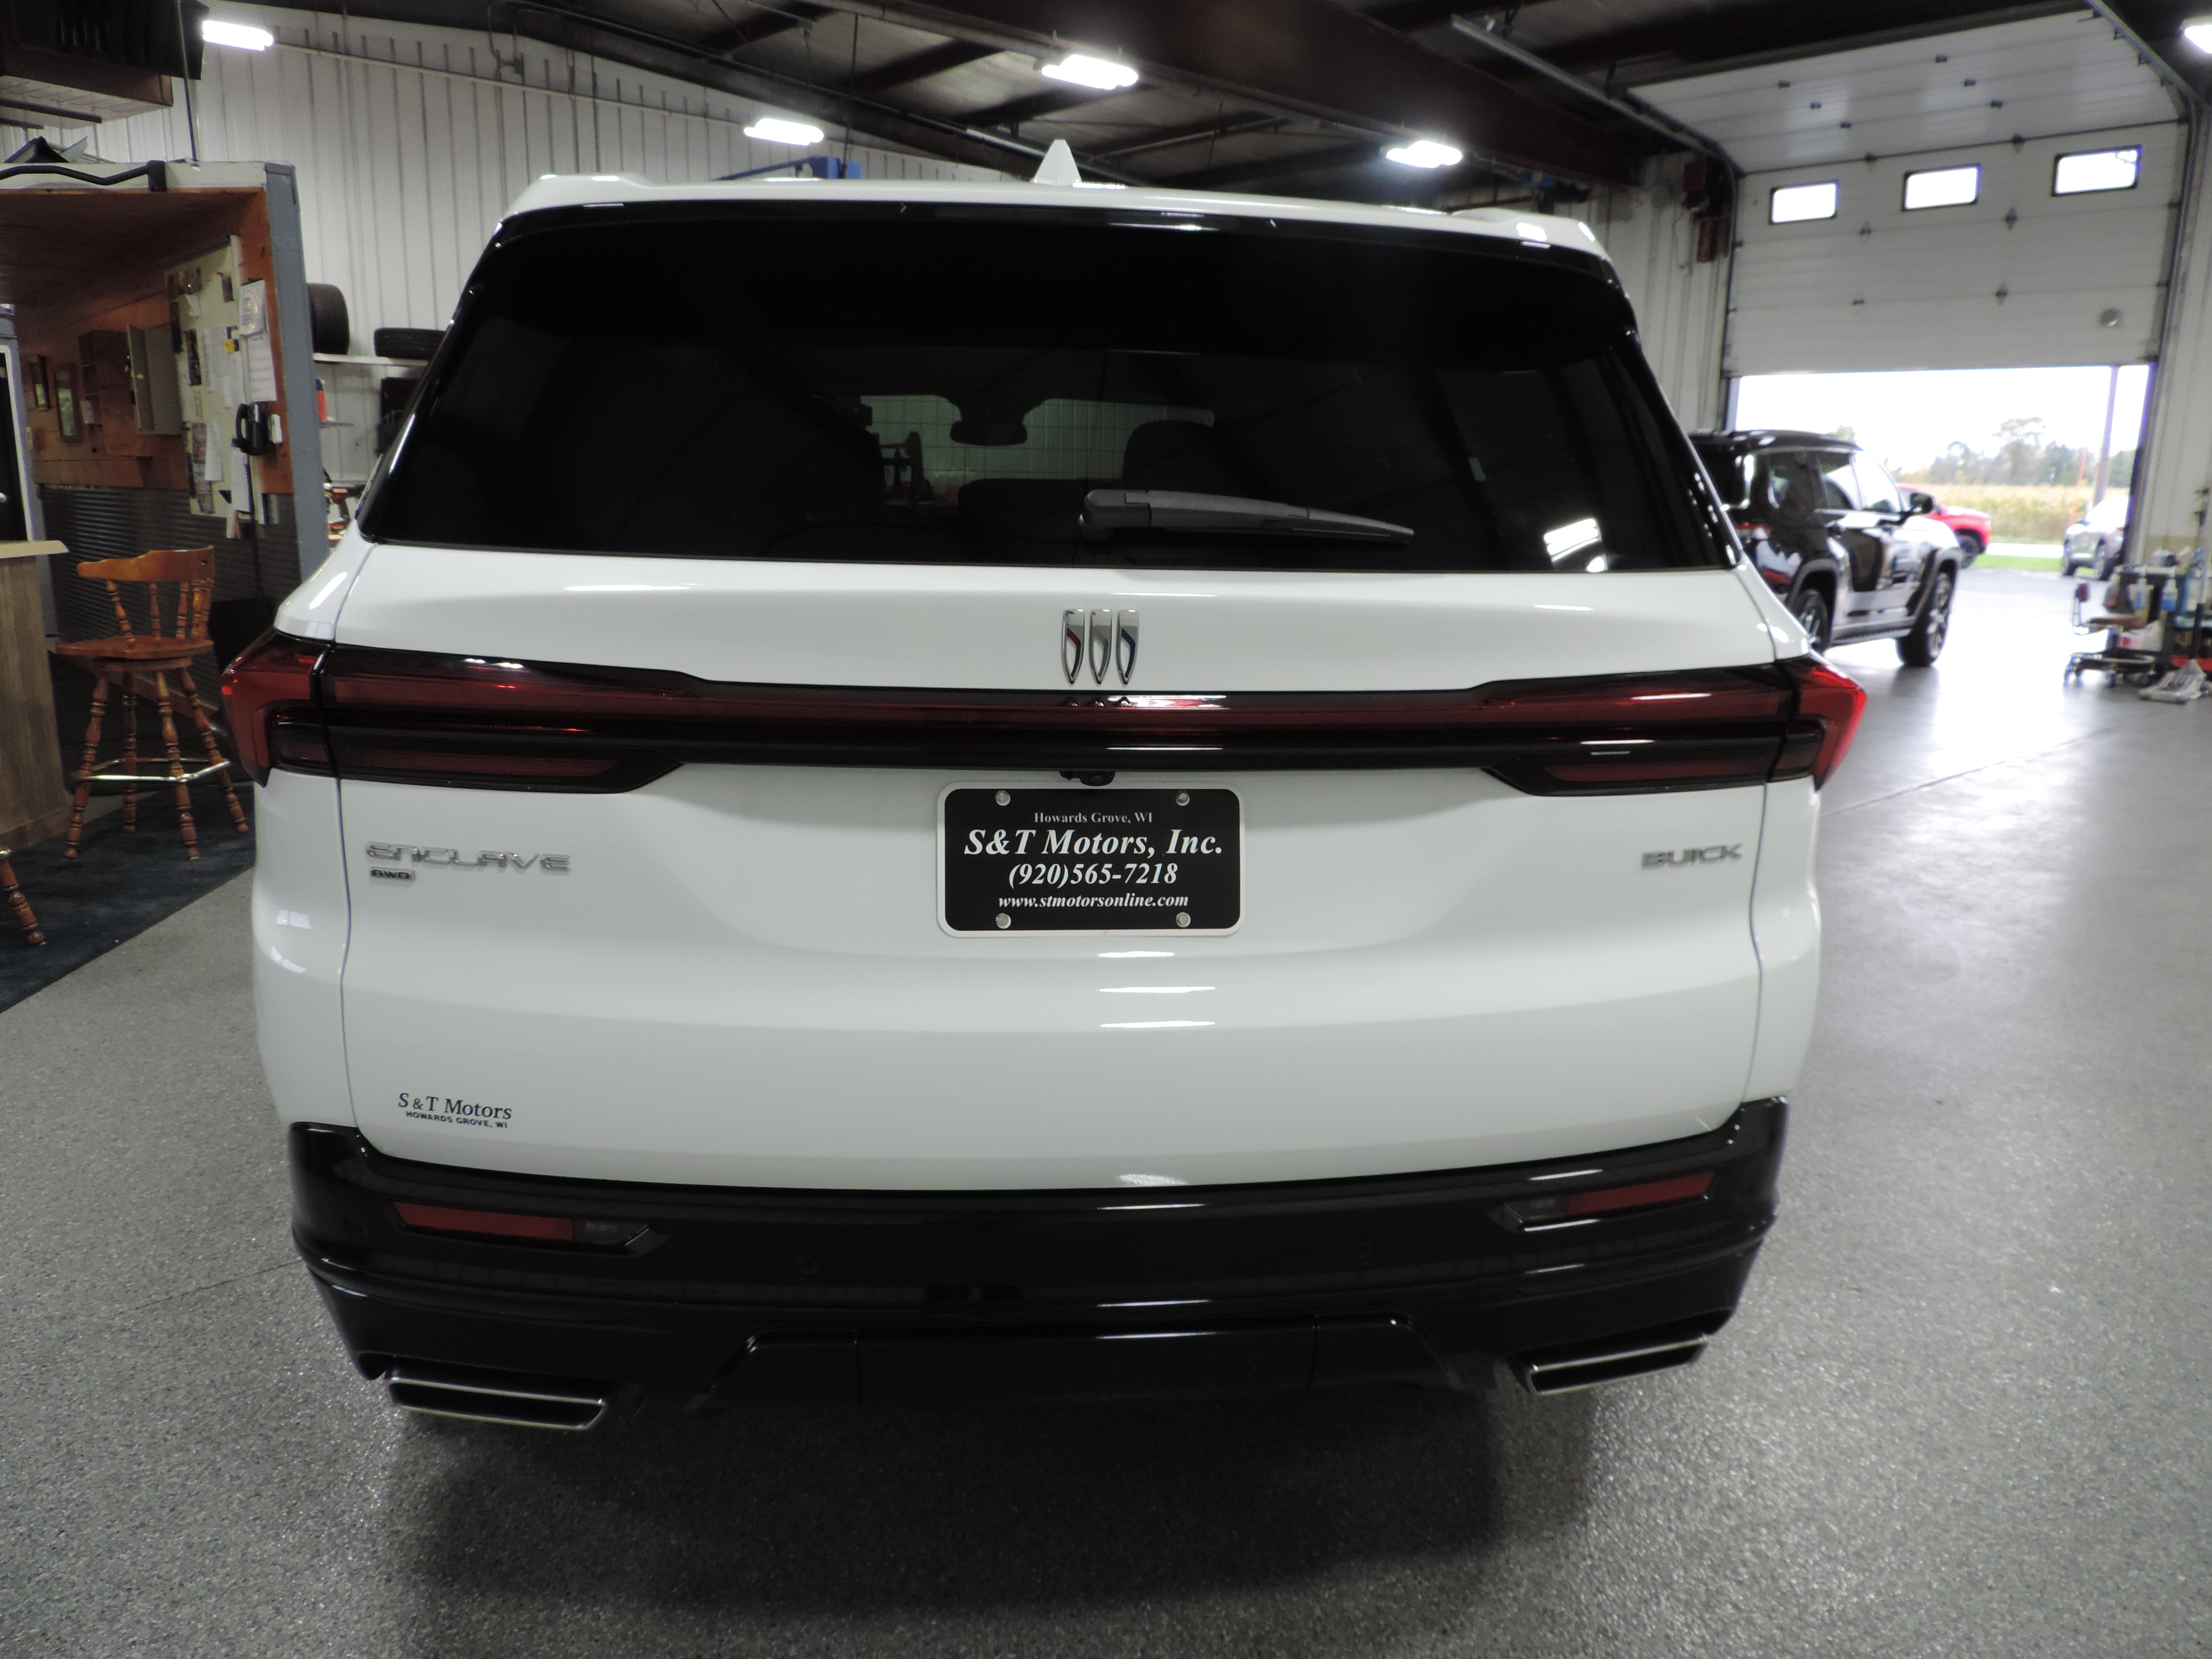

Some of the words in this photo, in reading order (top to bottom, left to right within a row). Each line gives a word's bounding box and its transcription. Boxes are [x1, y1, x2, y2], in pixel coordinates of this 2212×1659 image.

[1035, 812, 1087, 823] Howards
[1091, 812, 1131, 824] Grove,
[1134, 812, 1153, 823] WI
[964, 829, 1036, 855] S&T
[1041, 829, 1156, 858] Motors,
[1166, 829, 1223, 854] Inc.
[365, 842, 571, 871] ENCLAVE
[1641, 843, 1743, 868] BUICK
[371, 869, 410, 880] AWD
[1008, 863, 1178, 888] (920)565-7218
[998, 893, 1189, 908] www.stmotorsonline.com
[406, 1111, 453, 1123] HOWARDS
[456, 1117, 492, 1128] GROVE,
[444, 1098, 513, 1120] Motors
